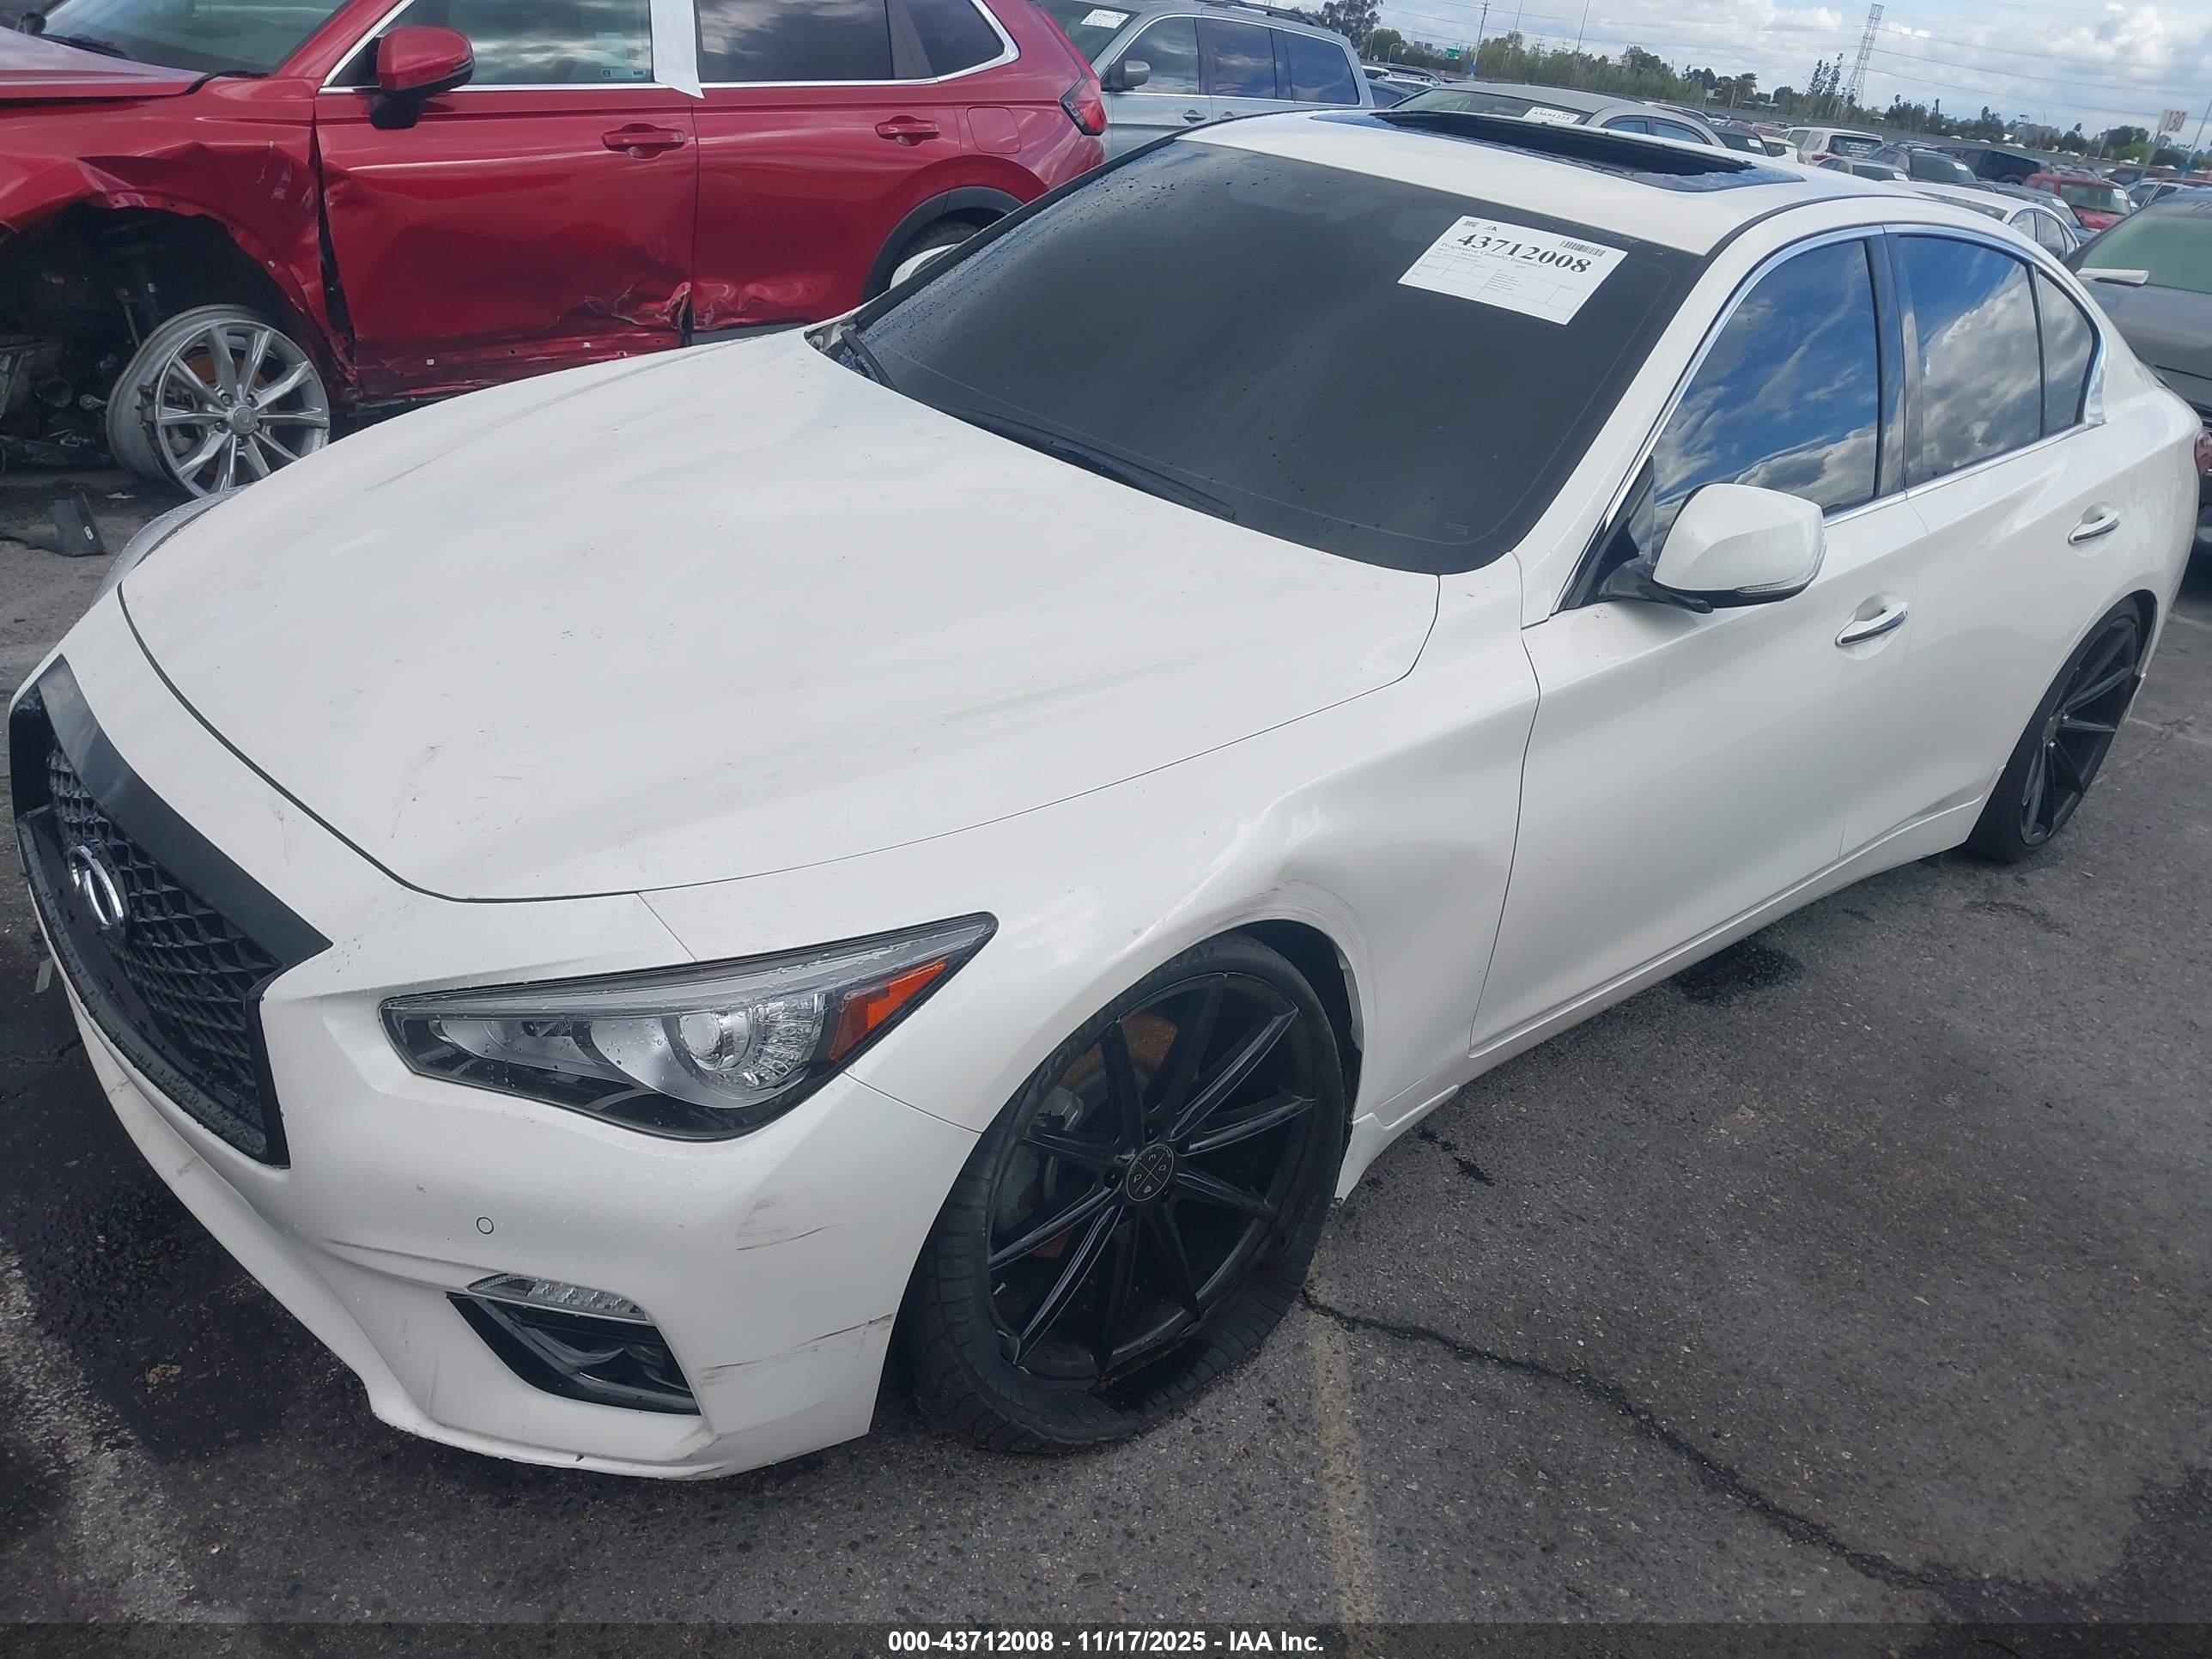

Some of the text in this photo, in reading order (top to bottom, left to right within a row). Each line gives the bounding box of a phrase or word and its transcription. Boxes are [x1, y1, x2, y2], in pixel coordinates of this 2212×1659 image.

[2164, 111, 2185, 131] 130
[1441, 242, 1480, 255] Progressive
[1480, 250, 1509, 262] Casualty
[1510, 256, 1544, 269] Insurance
[1456, 234, 1592, 273] 43712008
